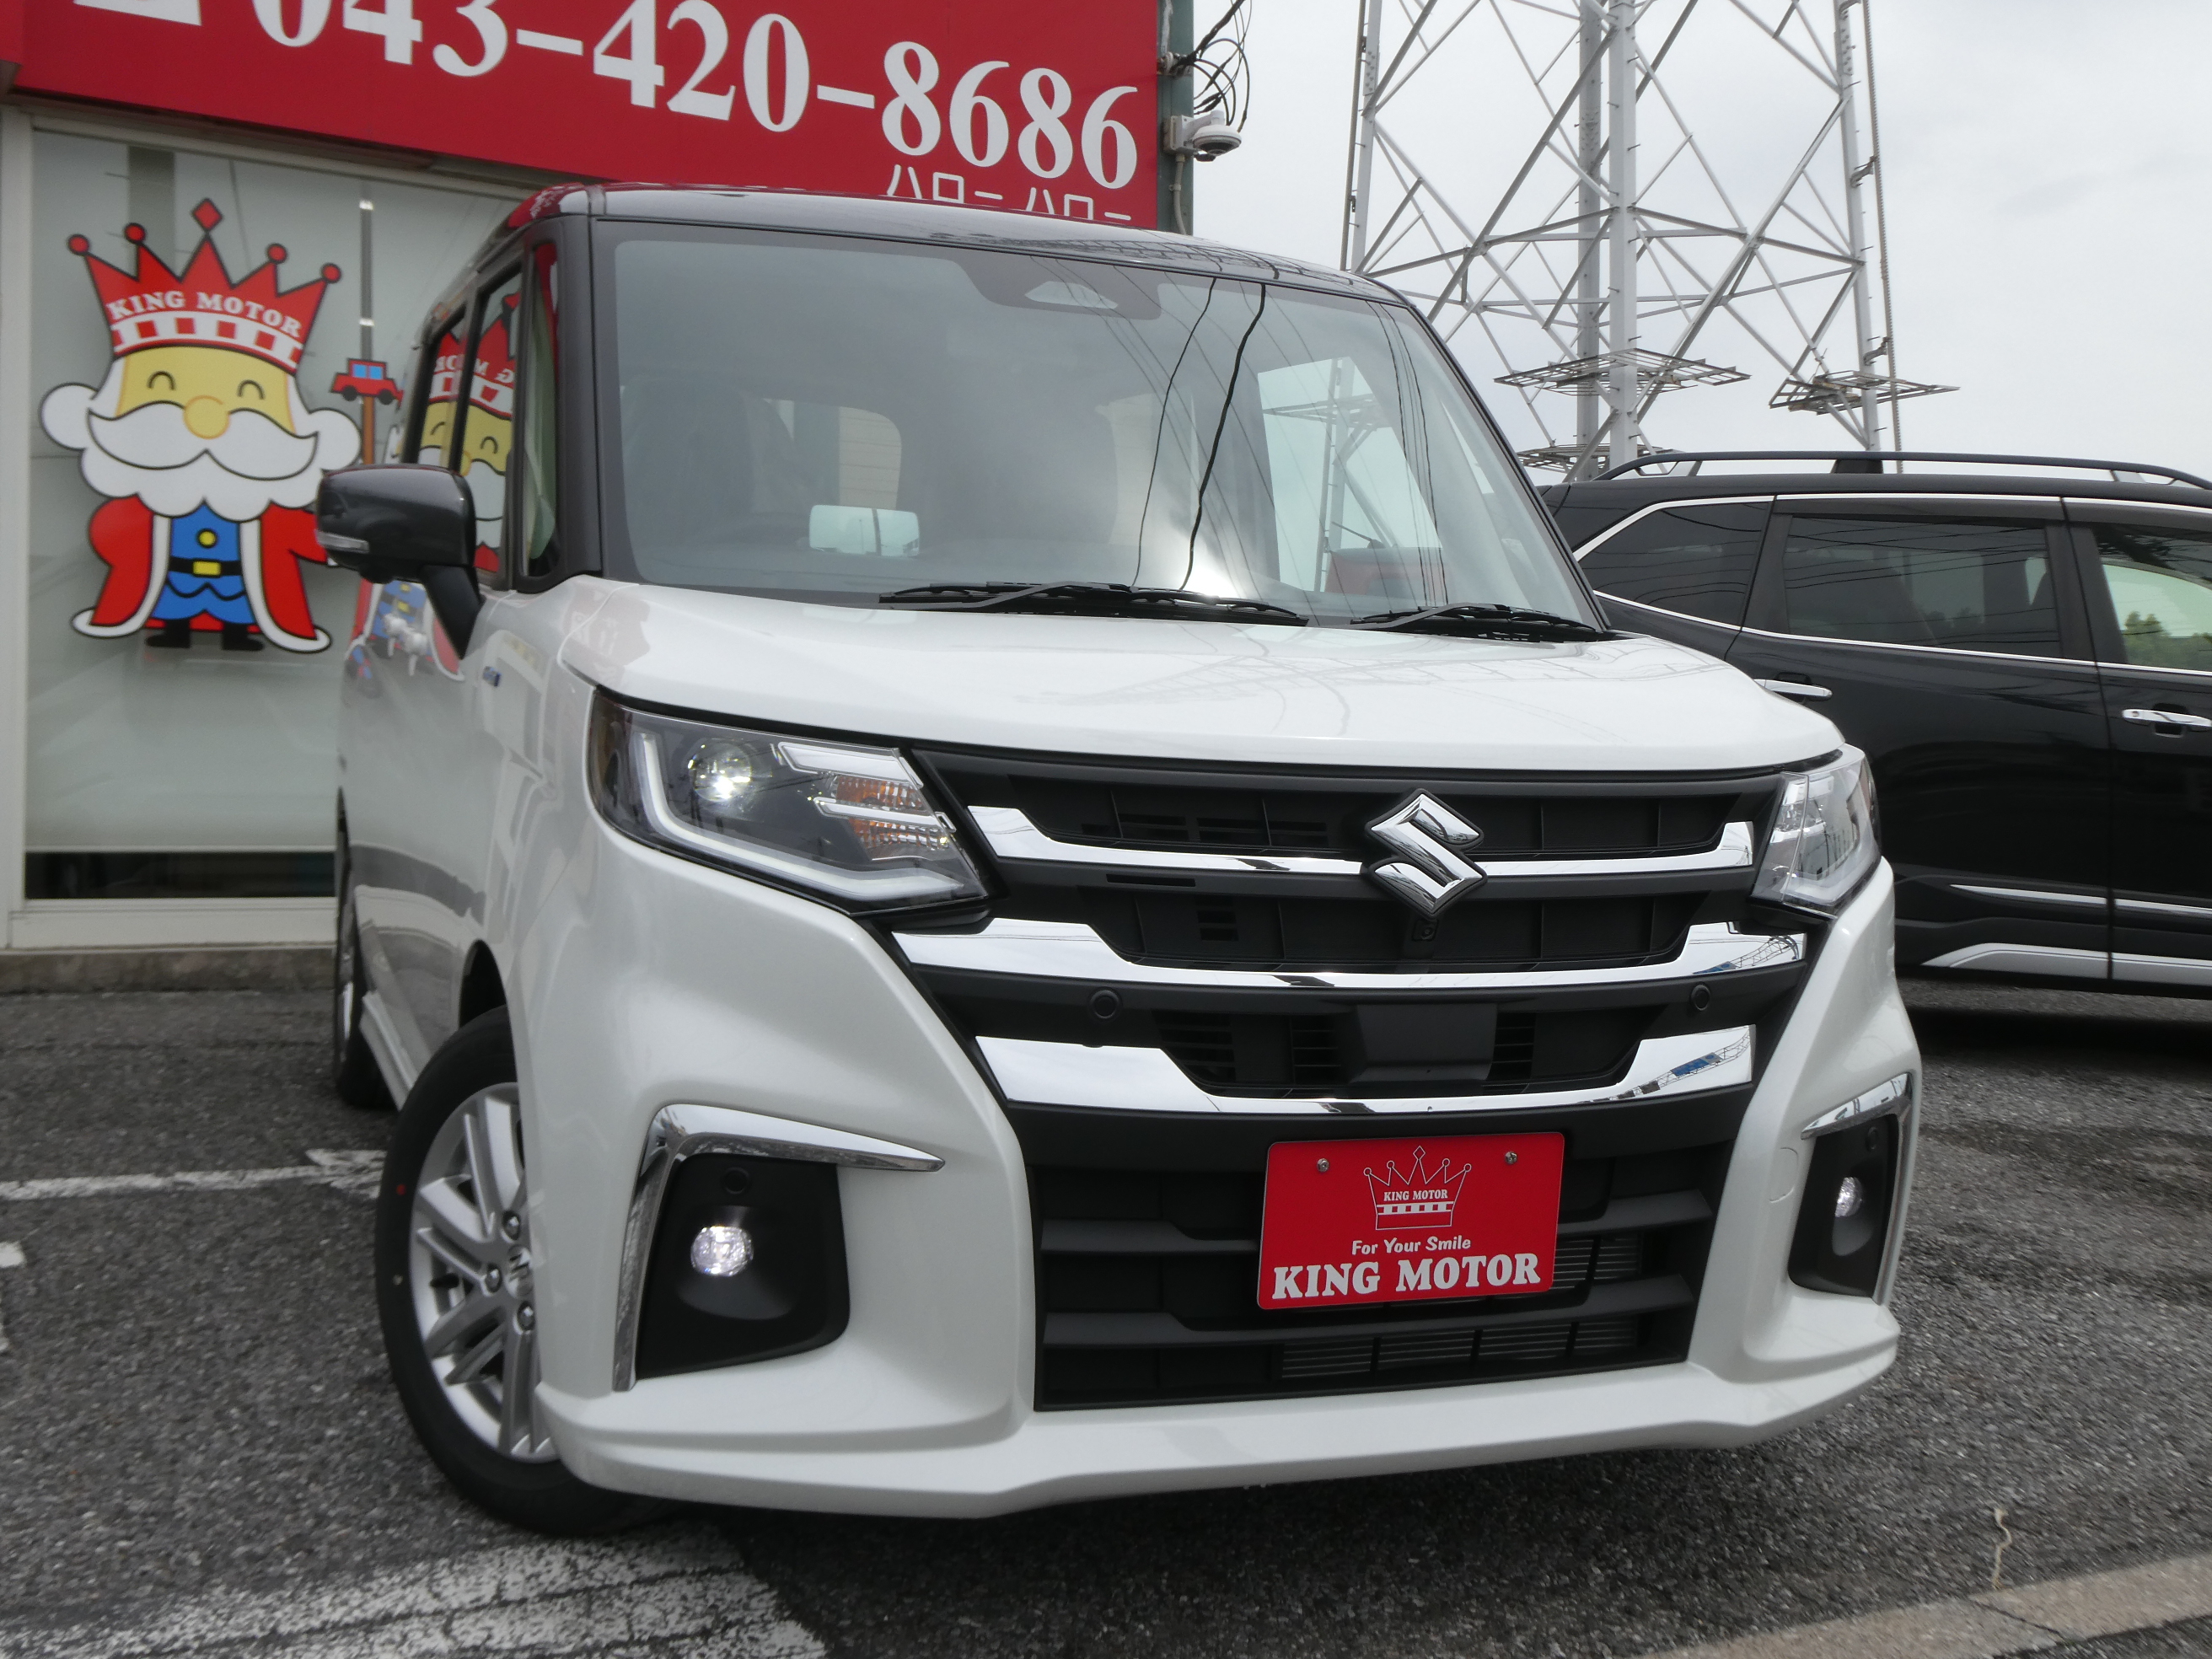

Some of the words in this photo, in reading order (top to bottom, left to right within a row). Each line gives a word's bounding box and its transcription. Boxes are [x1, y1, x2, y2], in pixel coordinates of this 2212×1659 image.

[106, 291, 185, 319] KING
[196, 292, 302, 338] MOTOR
[1383, 1190, 1409, 1202] KING
[1412, 1189, 1448, 1200] MOTOR
[1351, 1240, 1378, 1255] For
[1383, 1237, 1421, 1254] Your
[1425, 1235, 1472, 1251] Smile
[1272, 1261, 1381, 1300] KING
[1395, 1253, 1541, 1292] MOTOR
